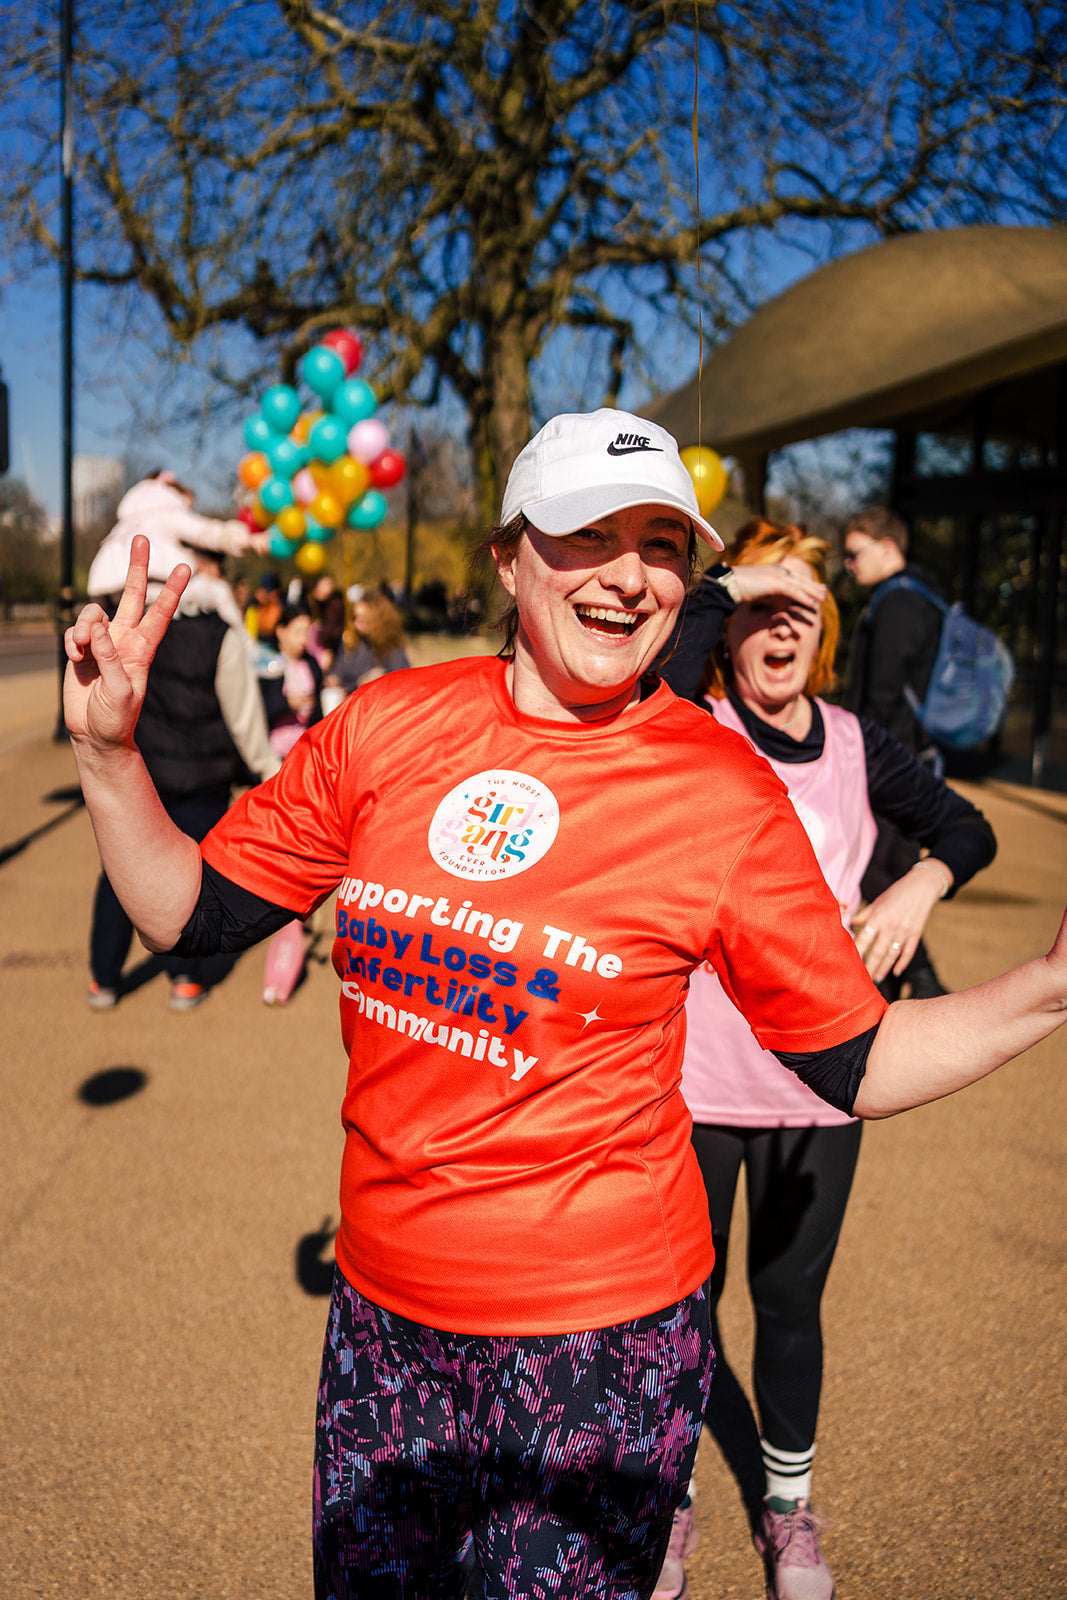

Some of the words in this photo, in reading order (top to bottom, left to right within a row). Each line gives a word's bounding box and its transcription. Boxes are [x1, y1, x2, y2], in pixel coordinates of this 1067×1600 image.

[615, 433, 651, 447] NIKE
[512, 780, 541, 798] WORST
[435, 815, 533, 863] gang
[439, 851, 506, 875] FOUNDATION
[459, 854, 485, 866] EVER
[338, 876, 523, 953] upporting
[542, 925, 623, 978] The
[337, 909, 414, 960] Baby
[420, 933, 518, 987] Loss
[526, 968, 561, 1003] &
